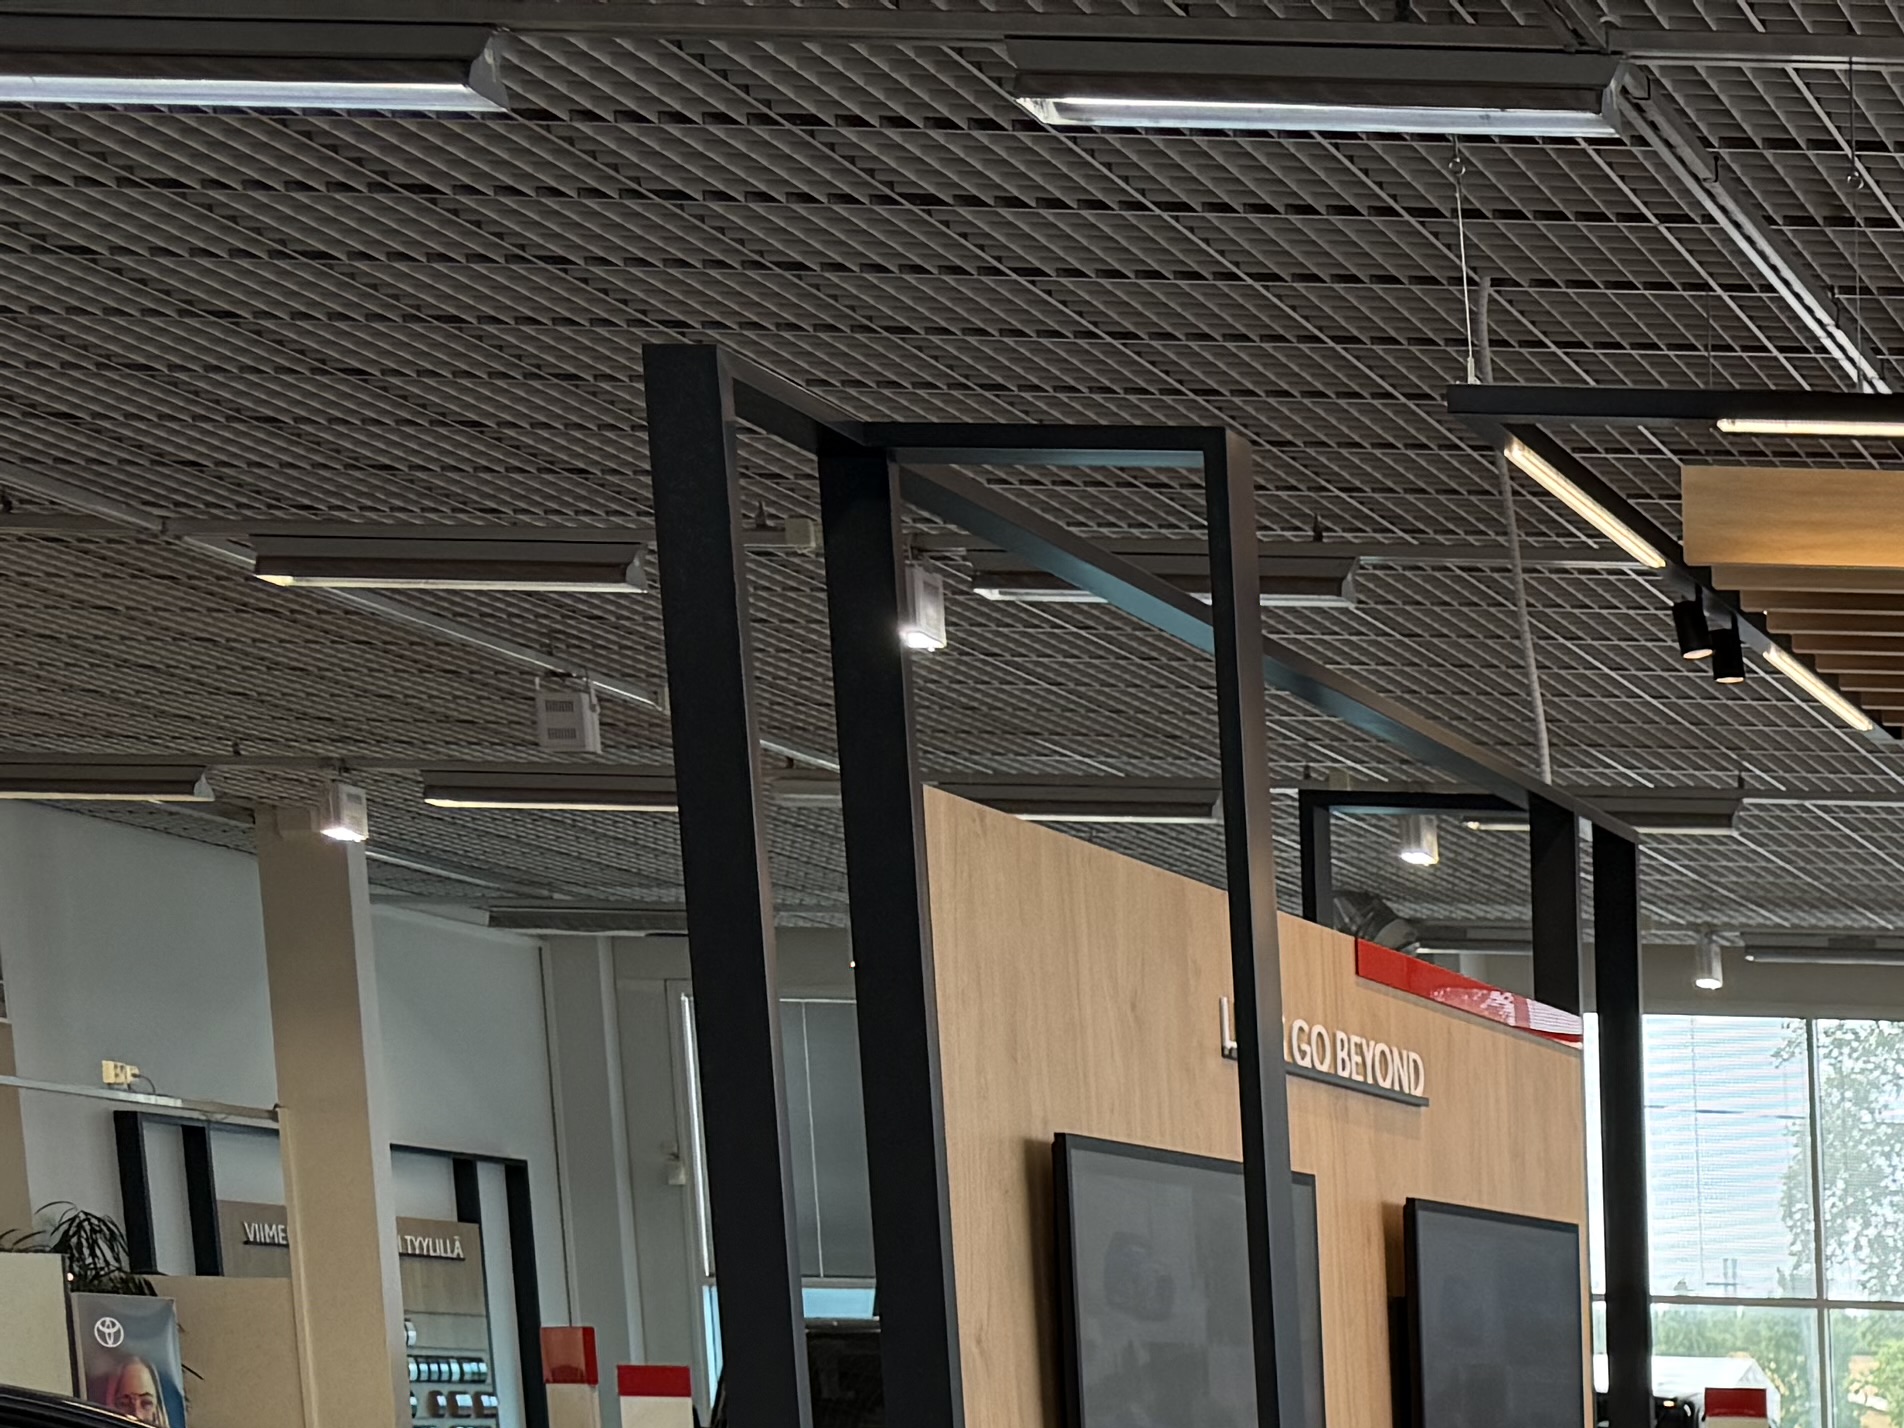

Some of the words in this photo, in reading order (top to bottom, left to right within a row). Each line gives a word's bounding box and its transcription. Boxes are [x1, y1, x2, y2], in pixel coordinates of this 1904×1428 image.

[1291, 1018, 1331, 1073] GO
[1335, 1030, 1425, 1097] BEYOND
[244, 1221, 288, 1245] VIIME
[404, 1235, 464, 1259] TYYLILLÄ
